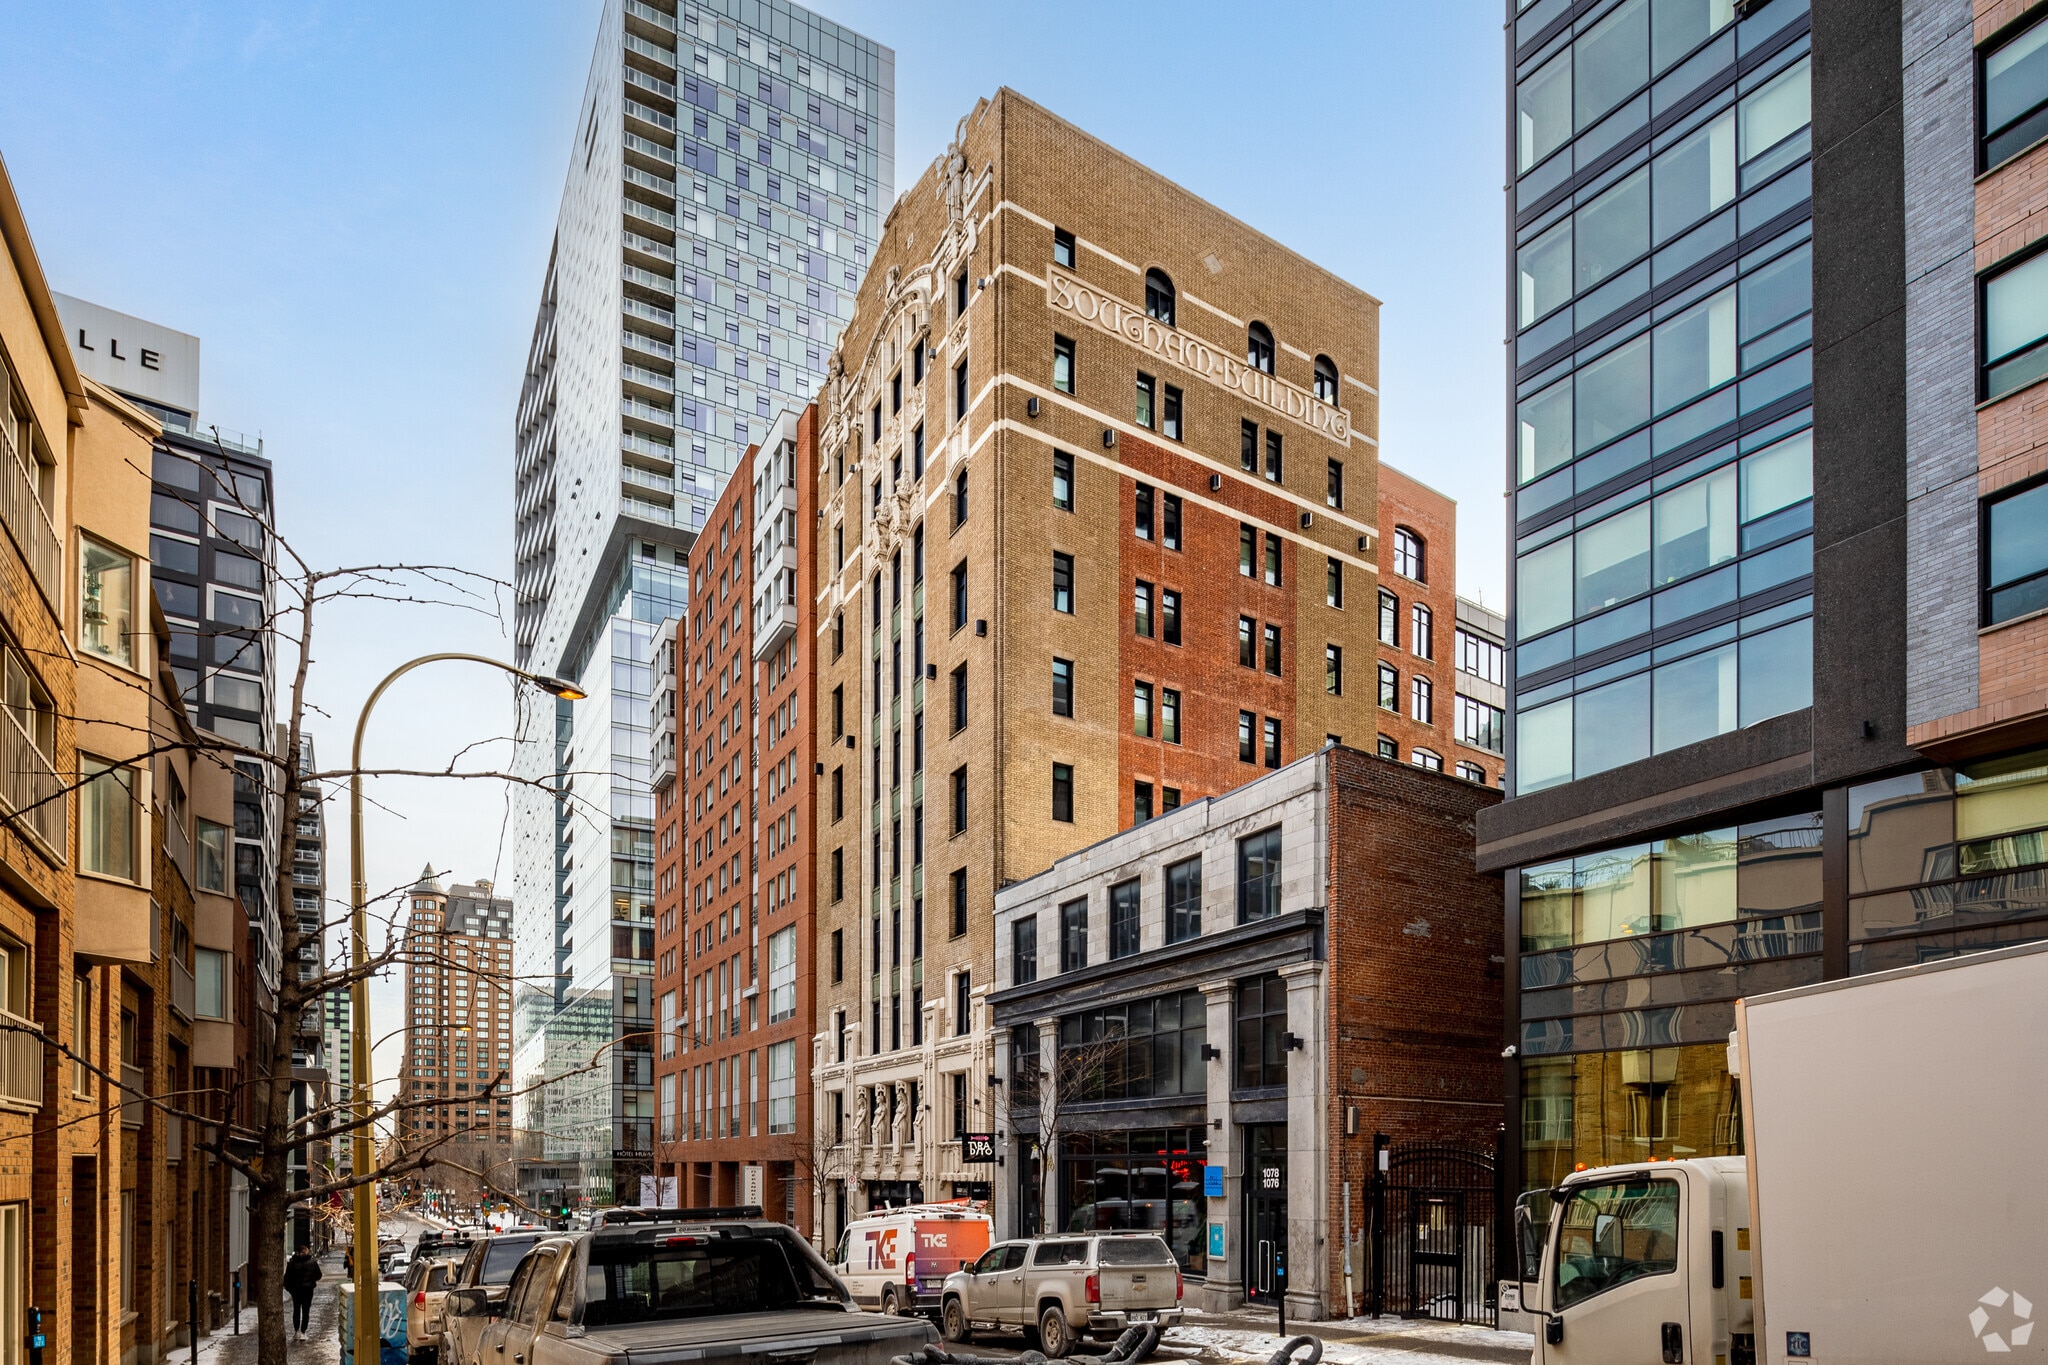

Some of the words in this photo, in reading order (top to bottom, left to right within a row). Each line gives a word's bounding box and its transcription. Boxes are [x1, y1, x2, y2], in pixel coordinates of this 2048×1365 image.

[1262, 1167, 1280, 1178] 1078
[1262, 1178, 1280, 1188] 1076
[921, 1233, 948, 1248] TKE
[865, 1228, 898, 1270] TKE
